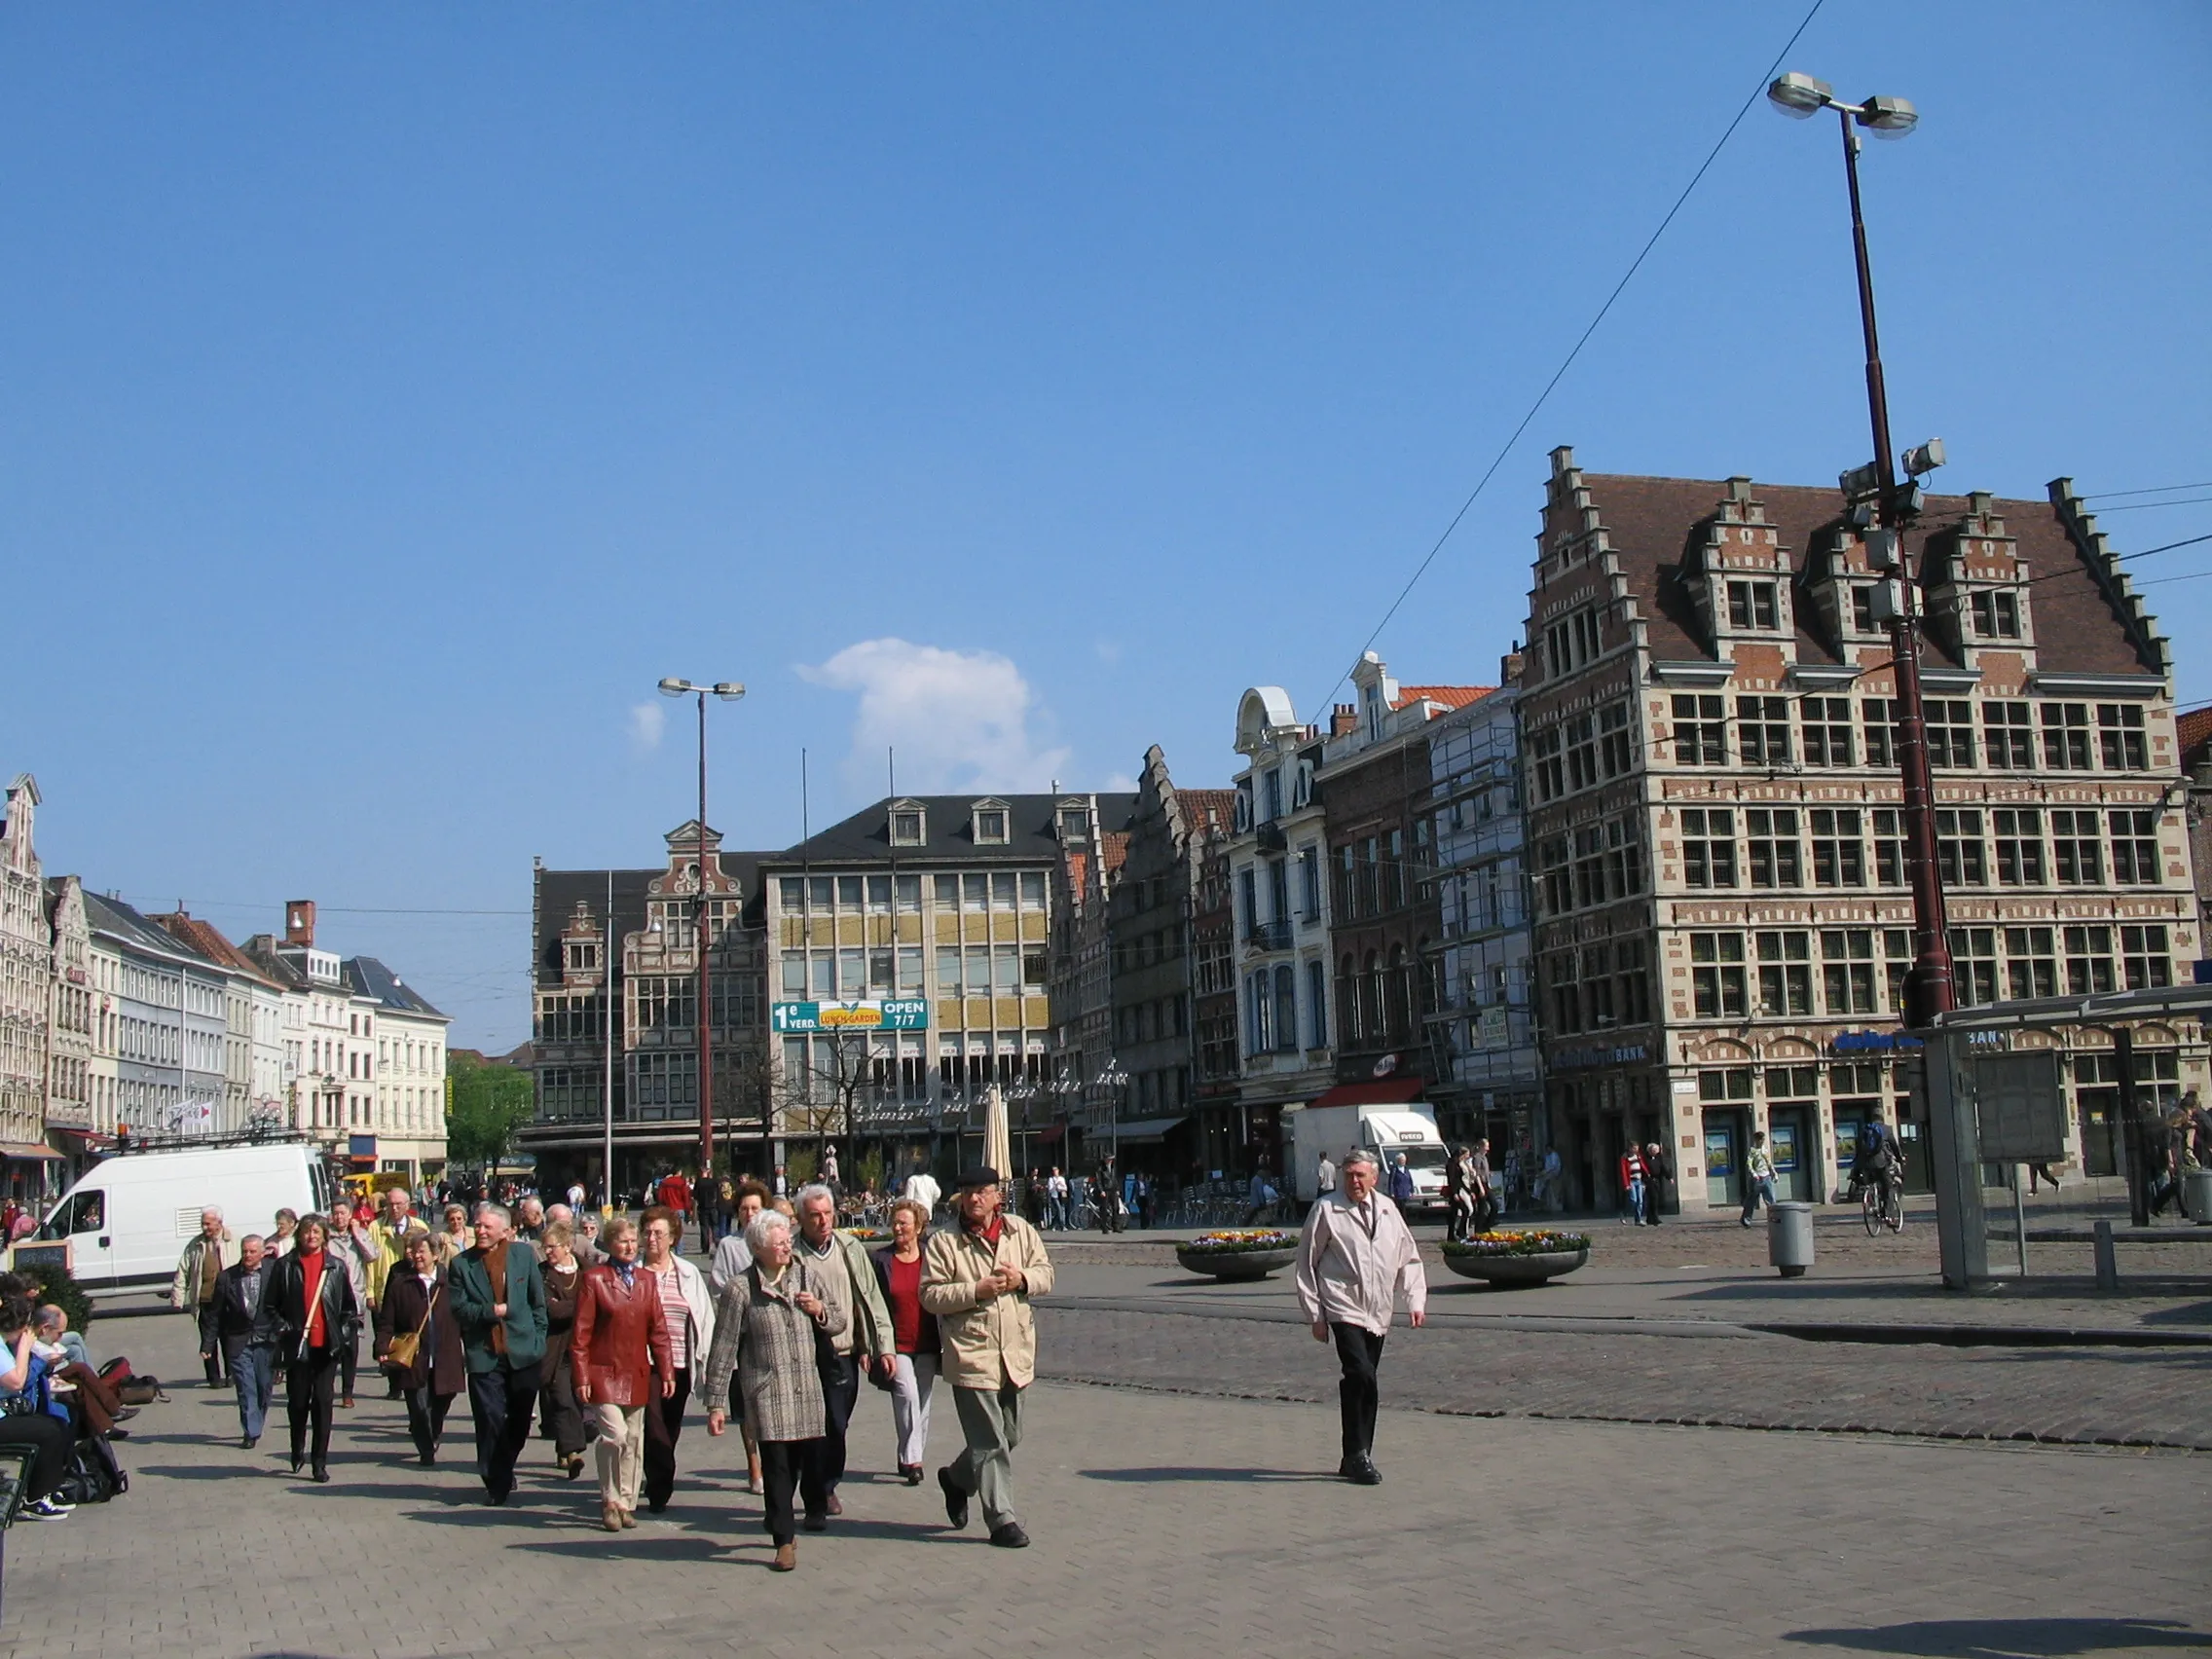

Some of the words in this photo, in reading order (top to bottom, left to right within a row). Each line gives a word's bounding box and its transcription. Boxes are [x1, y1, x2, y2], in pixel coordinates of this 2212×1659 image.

[884, 1002, 924, 1014] OPEN
[790, 1019, 817, 1029] VERD.
[821, 1014, 847, 1024] LUNCH
[849, 1014, 881, 1023] GARDEN
[894, 1014, 915, 1026] 7/7
[1615, 1045, 1645, 1062] BANK
